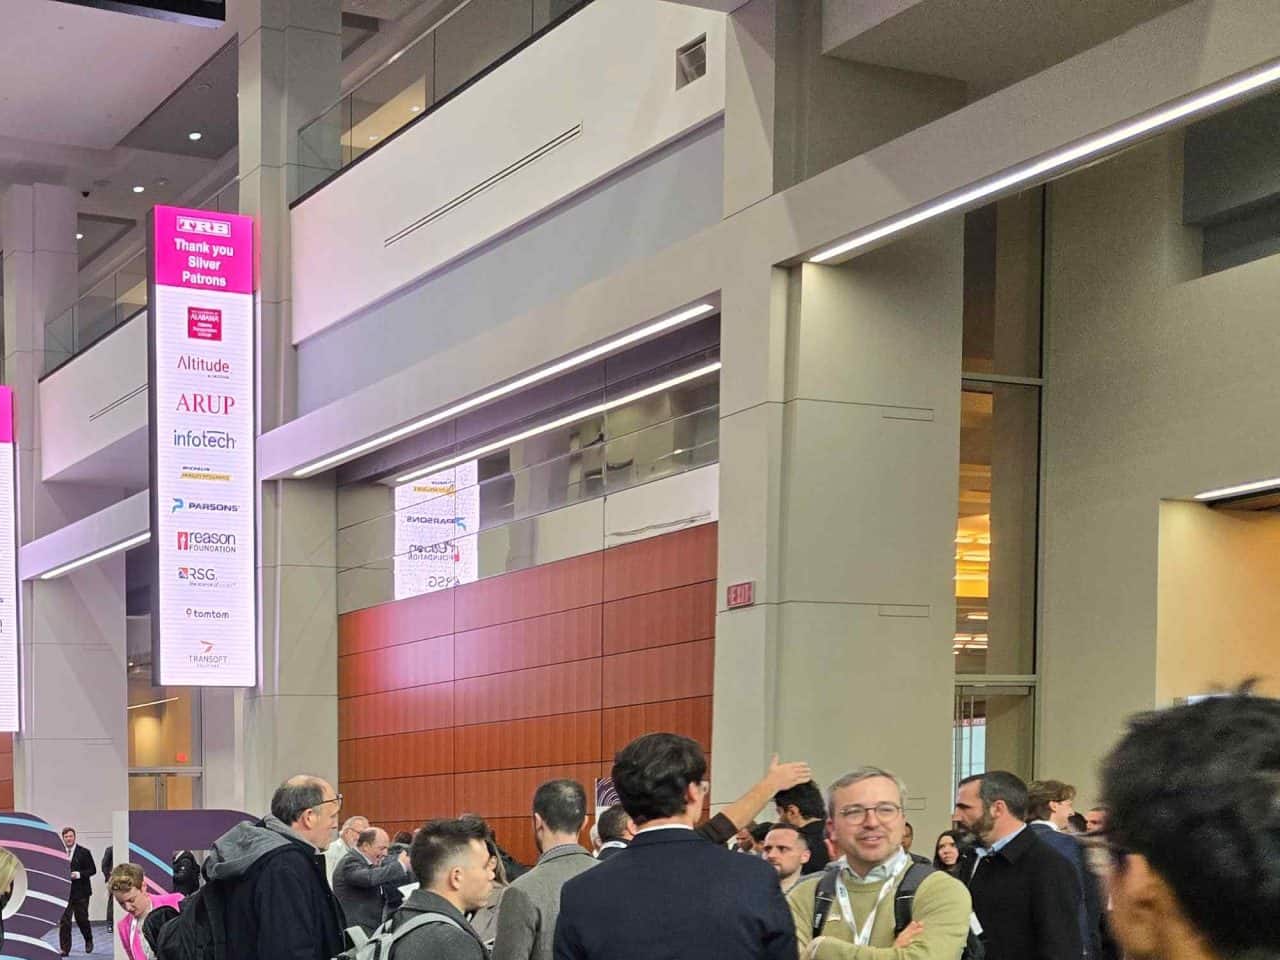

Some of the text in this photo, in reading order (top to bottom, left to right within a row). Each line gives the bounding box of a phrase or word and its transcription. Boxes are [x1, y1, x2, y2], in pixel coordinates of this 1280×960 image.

[179, 218, 229, 235] TRB
[174, 238, 234, 258] Thank you
[188, 255, 221, 271] Silver
[182, 272, 226, 287] Patrons
[177, 355, 229, 373] Altitude
[176, 393, 235, 415] ARUP
[174, 429, 235, 449] infotech
[189, 502, 238, 512] PARSONS
[189, 531, 236, 545] reason
[189, 545, 236, 553] FOUNDATION
[194, 609, 230, 619] tomtom
